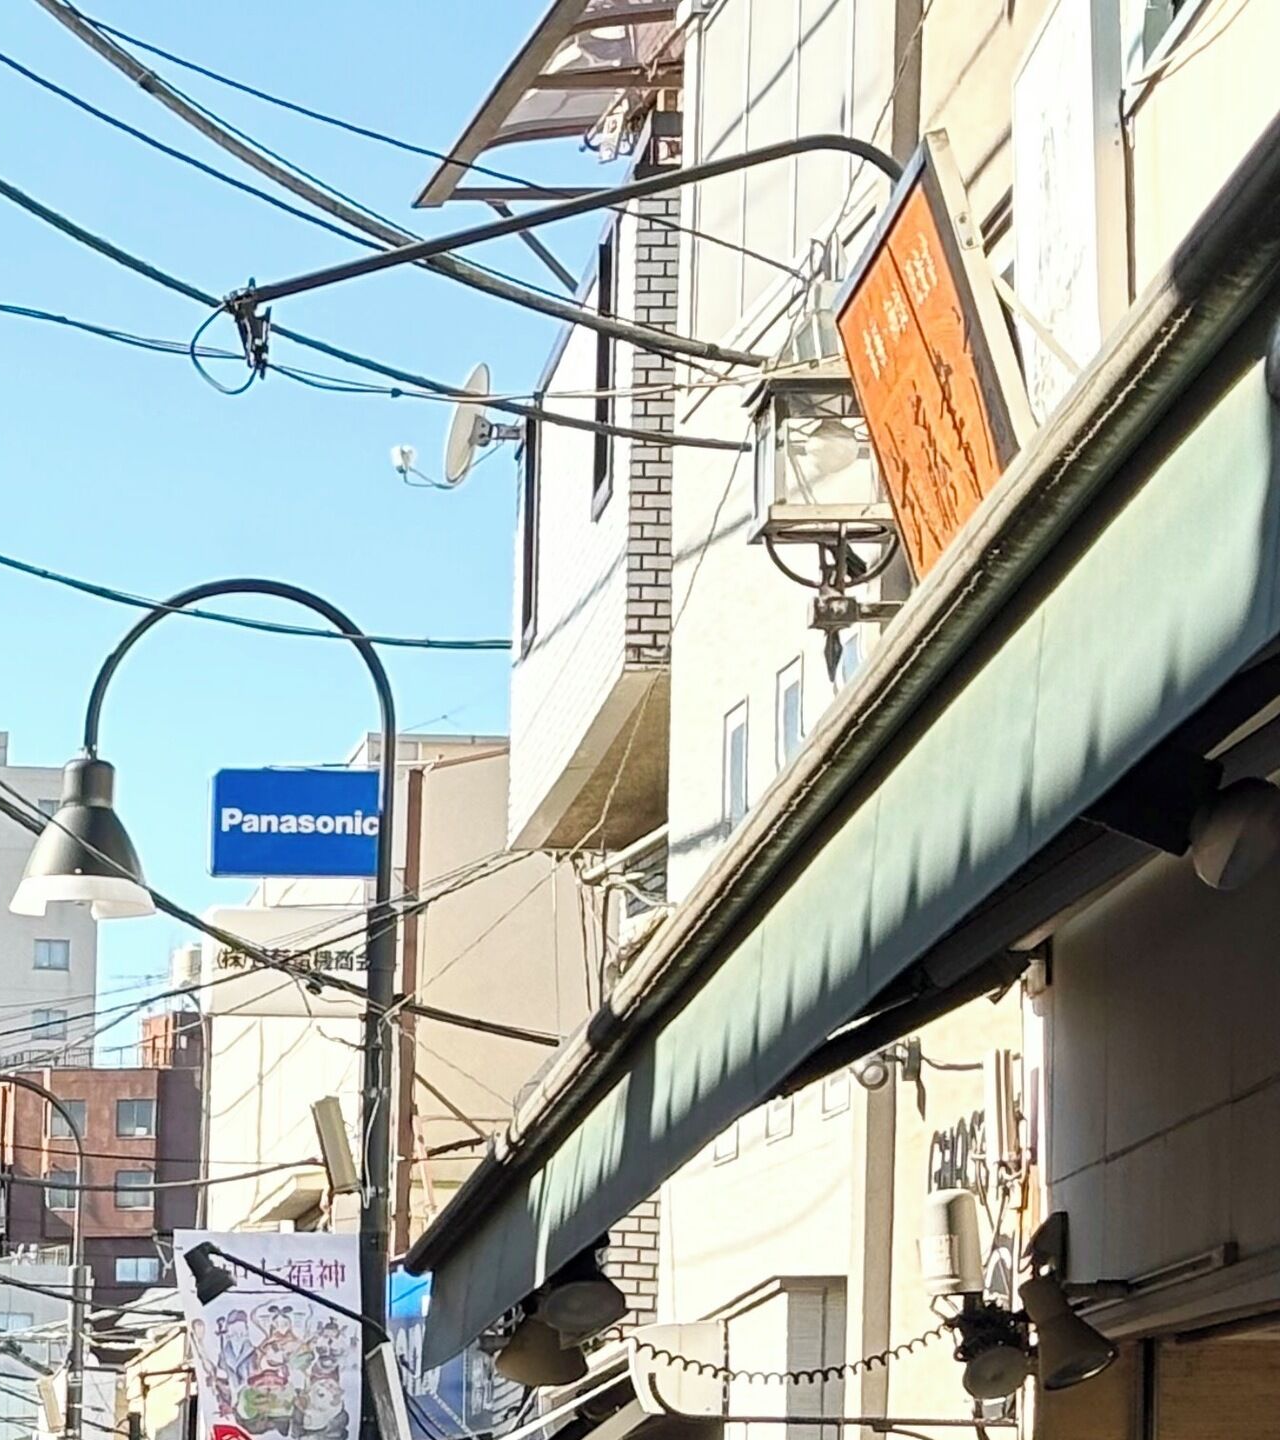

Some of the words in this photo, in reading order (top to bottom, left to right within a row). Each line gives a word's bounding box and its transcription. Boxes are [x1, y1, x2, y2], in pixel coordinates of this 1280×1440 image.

[220, 807, 379, 837] Panasonic
[223, 1257, 347, 1290] 七福神
